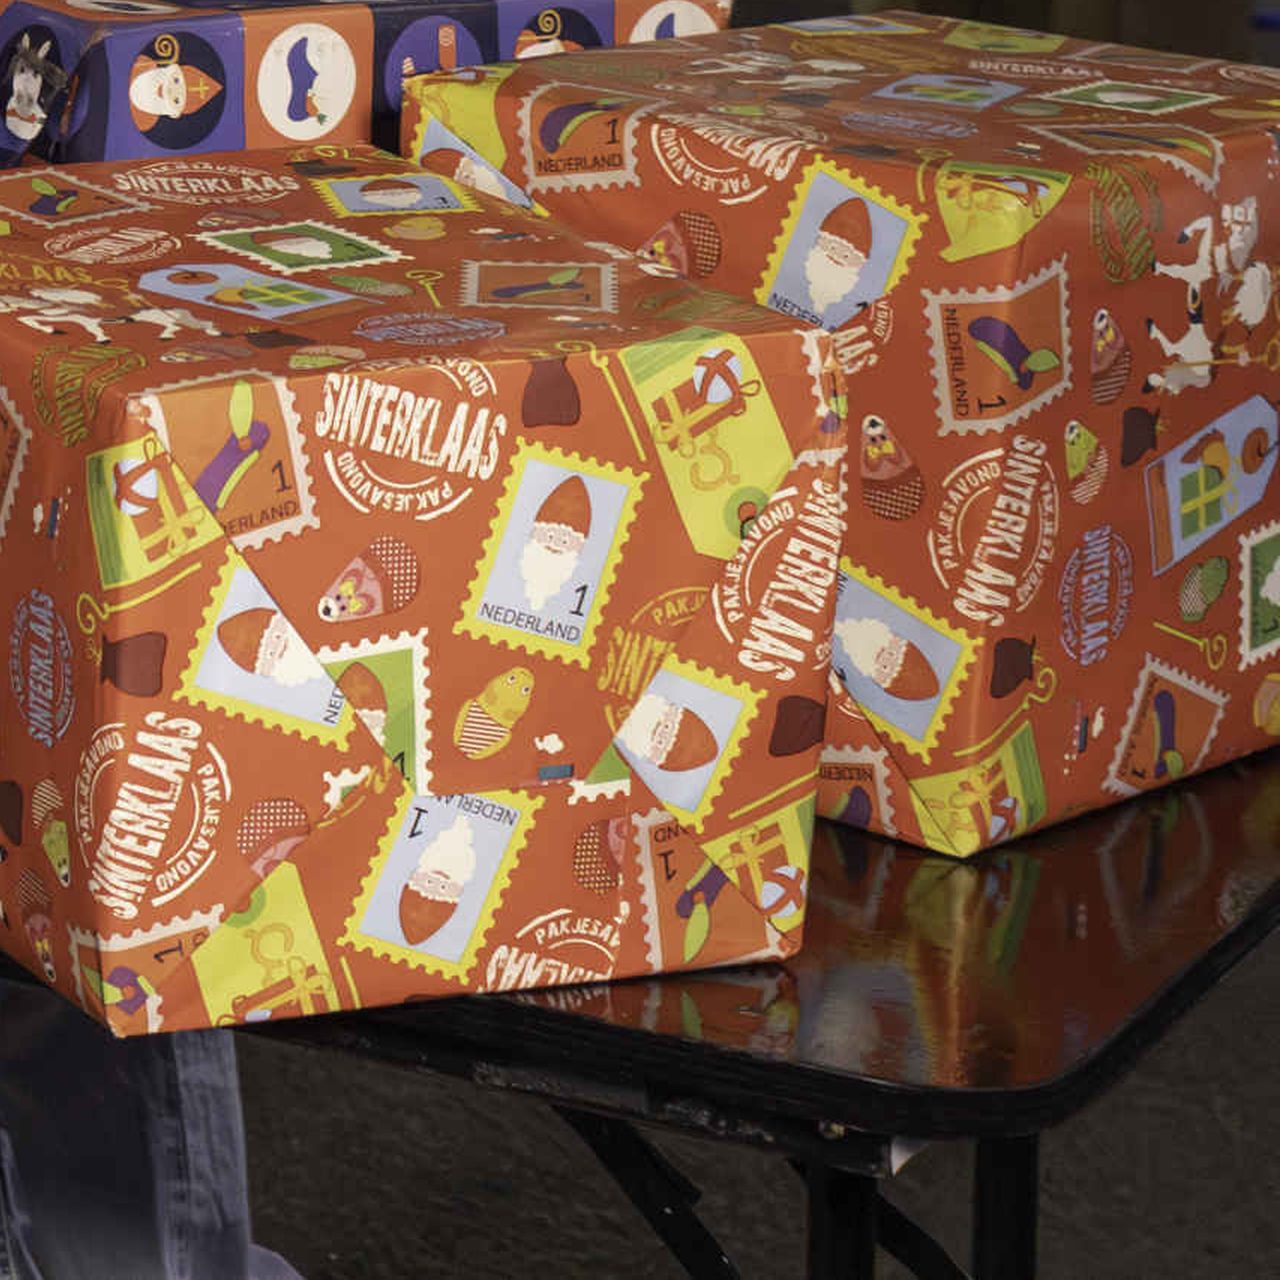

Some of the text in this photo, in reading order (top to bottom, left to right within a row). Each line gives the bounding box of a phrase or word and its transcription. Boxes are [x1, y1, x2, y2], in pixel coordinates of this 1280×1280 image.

[605, 118, 618, 145] 1
[112, 172, 301, 196] SINTERKLAAS
[537, 151, 624, 174] NEDERLAND
[660, 127, 751, 195] PAKJESAVOND
[944, 307, 969, 417] NEDERLAND
[316, 372, 507, 482] SINTERKLAAS
[977, 396, 1007, 413] 1
[271, 458, 292, 494] 1
[336, 451, 453, 513] PAKJESAVOND
[223, 500, 297, 538] ERLAND
[938, 460, 1002, 571] PAKJESAVOND
[953, 434, 1047, 626] SINTERKLAAS
[722, 500, 794, 624] PAKJESAVOND
[738, 477, 848, 681] SINTERKLAAS
[569, 584, 589, 617] 1
[1081, 525, 1112, 666] SINTERKLAAS
[480, 601, 581, 643] NEDERLAND
[27, 588, 55, 748] SINTERKLAAS
[88, 711, 203, 920] SINTERKLAAS
[154, 763, 223, 893] PAKJESAVOND
[408, 807, 429, 840] 1
[655, 850, 678, 881] 1
[152, 939, 184, 964] 1
[535, 917, 621, 948] PAKJESA
